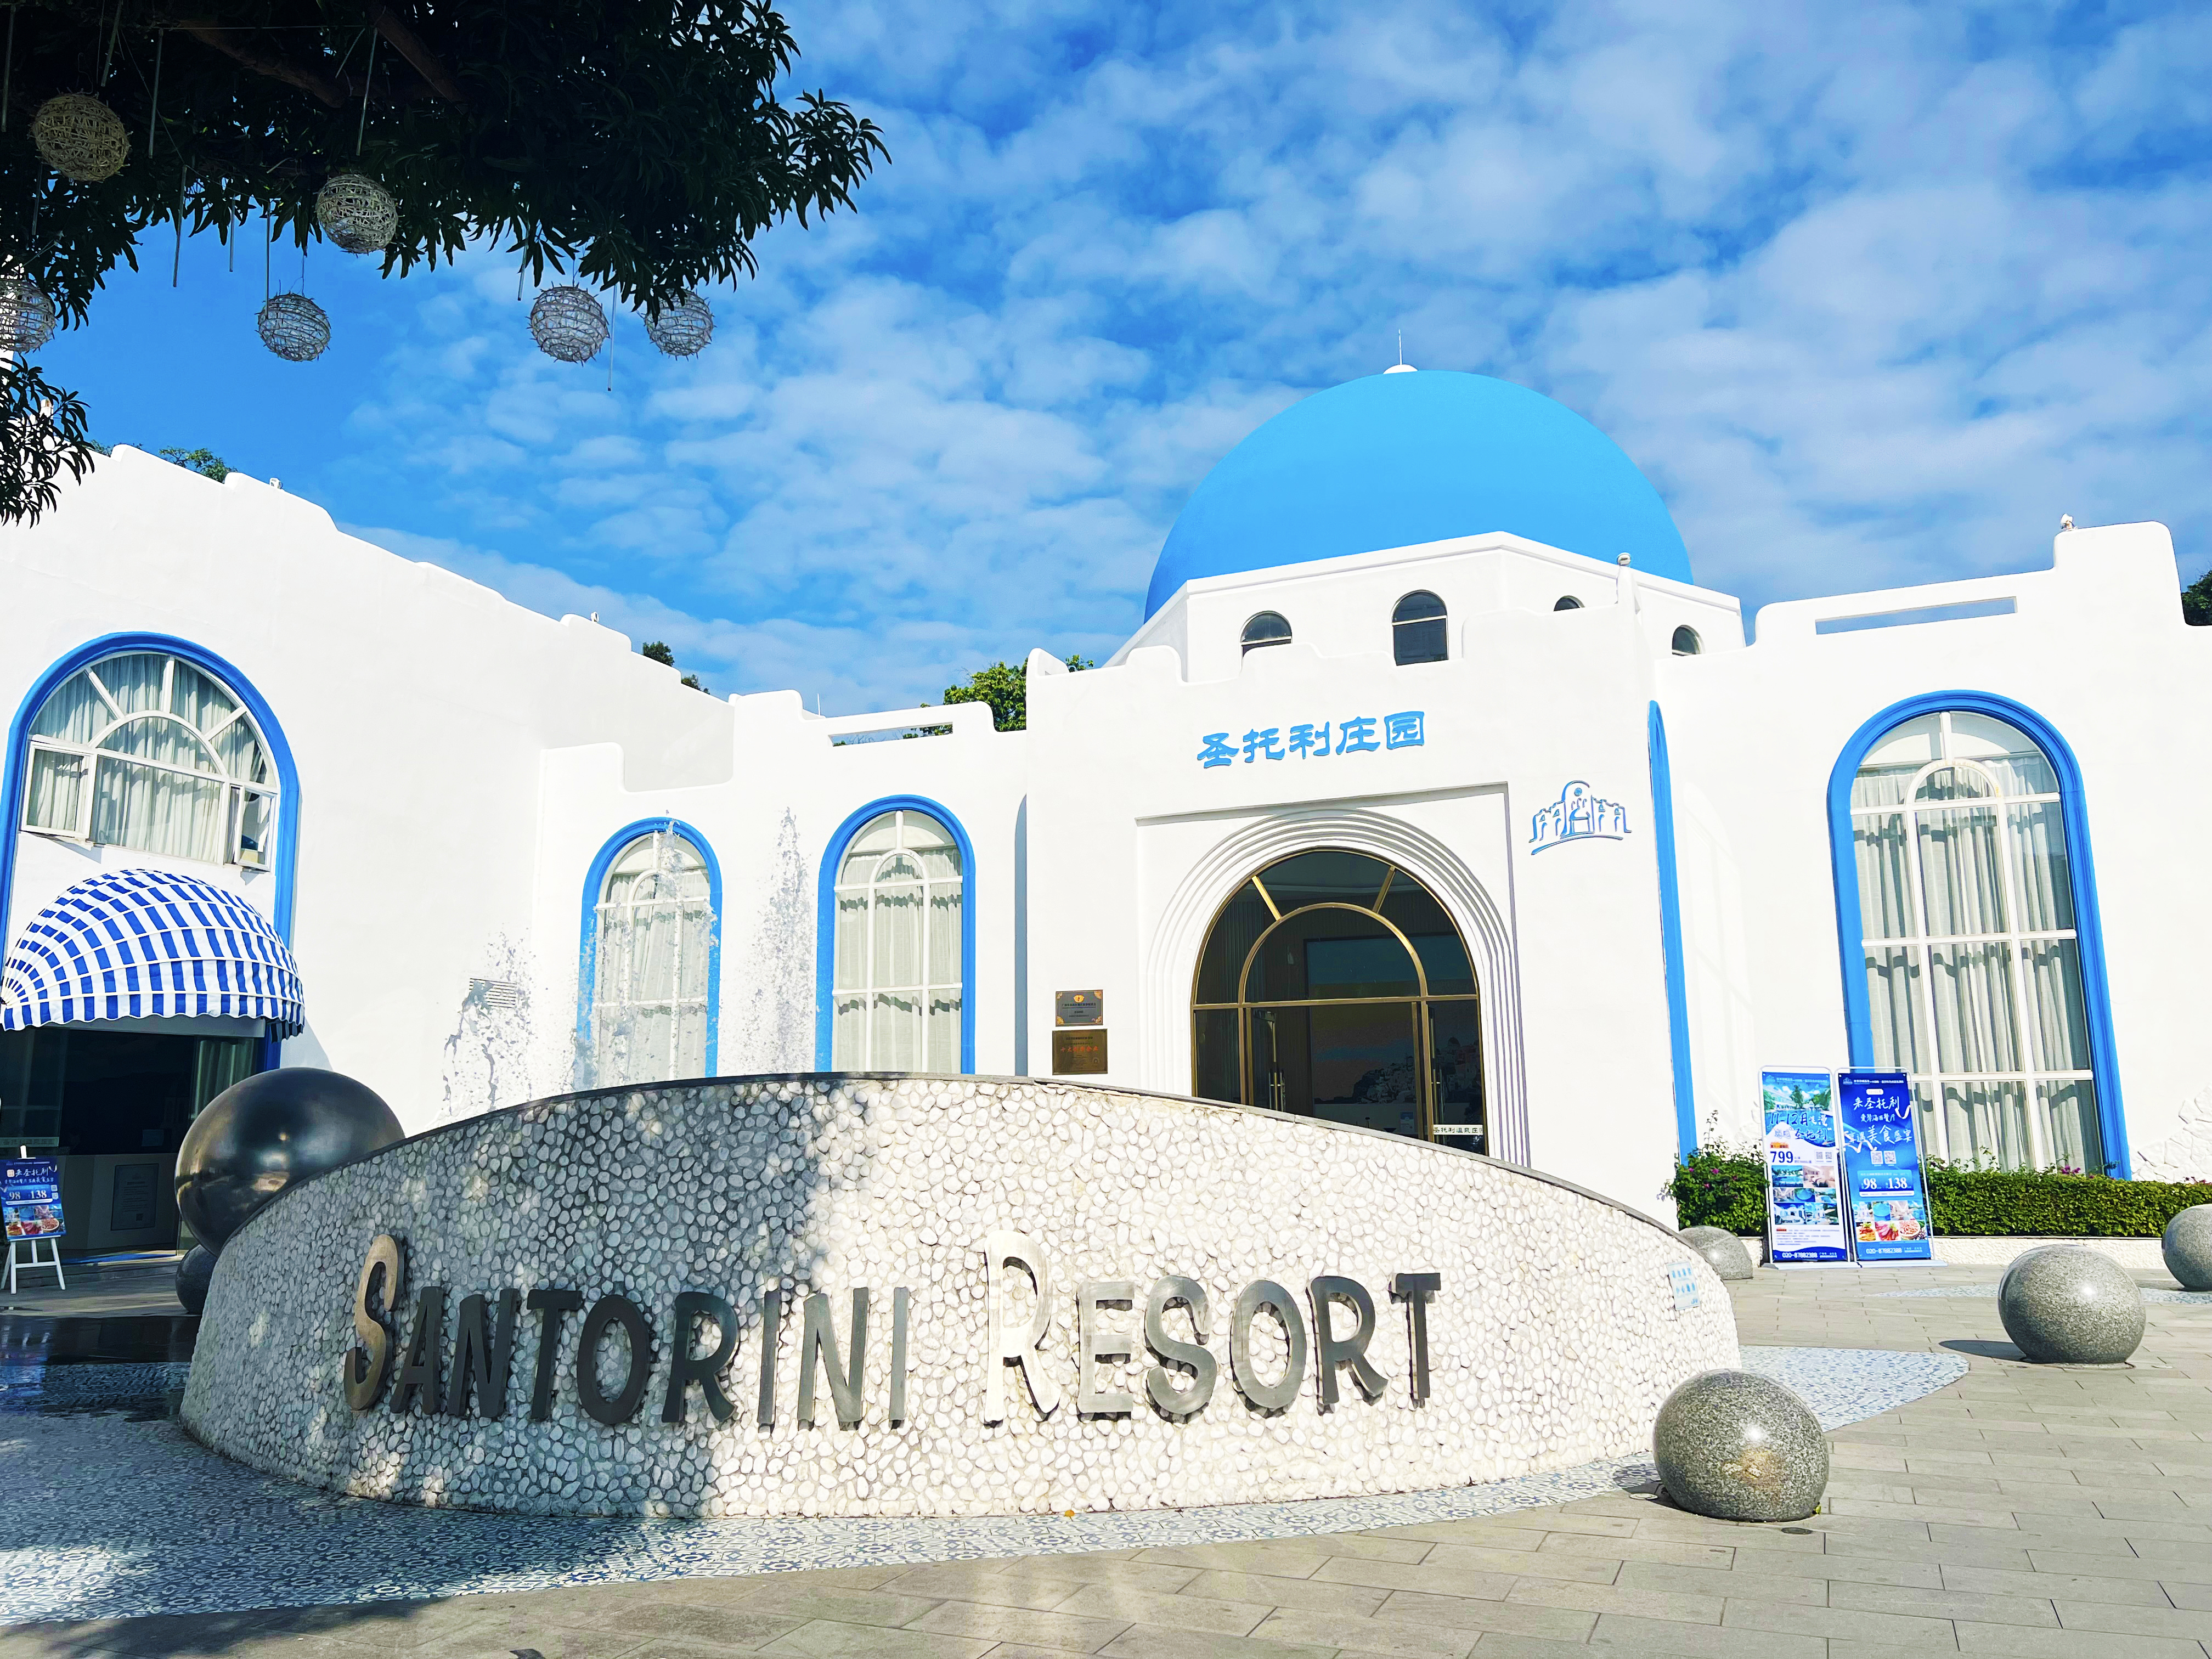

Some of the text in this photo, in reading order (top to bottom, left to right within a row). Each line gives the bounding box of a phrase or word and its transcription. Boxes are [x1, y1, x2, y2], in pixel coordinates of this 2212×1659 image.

[1197, 711, 1425, 769] 圣托利庄园
[1770, 1151, 1793, 1163] 799
[1863, 1178, 1877, 1189] 98
[1888, 1177, 1908, 1189] 138
[9, 1190, 47, 1200] 98 138
